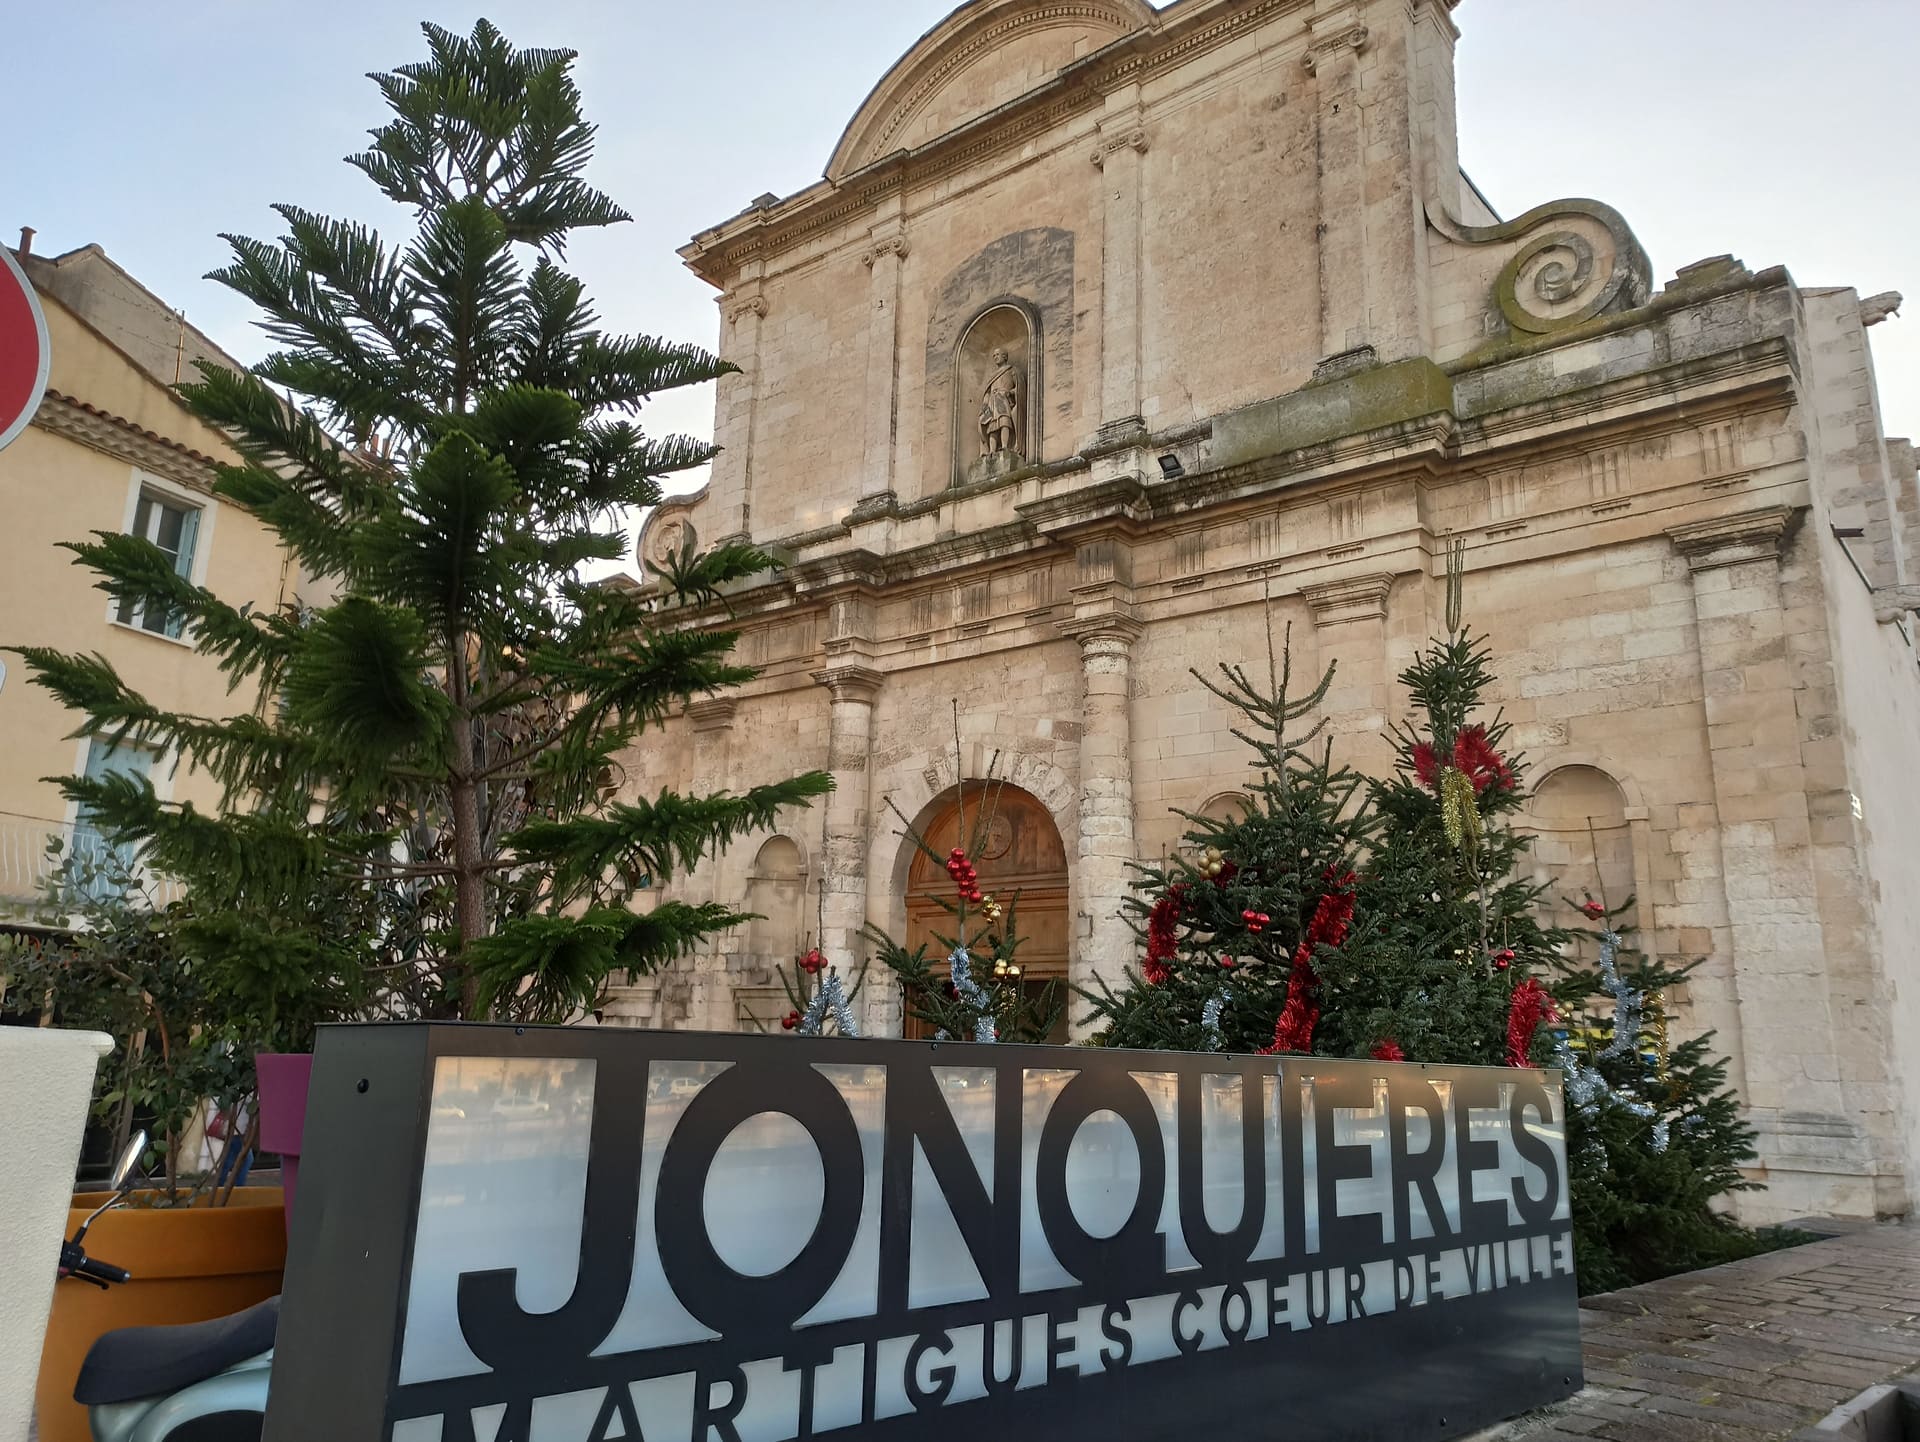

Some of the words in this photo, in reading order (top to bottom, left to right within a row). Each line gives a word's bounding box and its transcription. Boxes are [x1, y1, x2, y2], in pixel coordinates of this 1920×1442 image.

[457, 1056, 1561, 1373] JONQUIERES
[1172, 1264, 1368, 1355] COEUR
[1393, 1250, 1443, 1308] DE
[1463, 1232, 1566, 1295] VILLE
